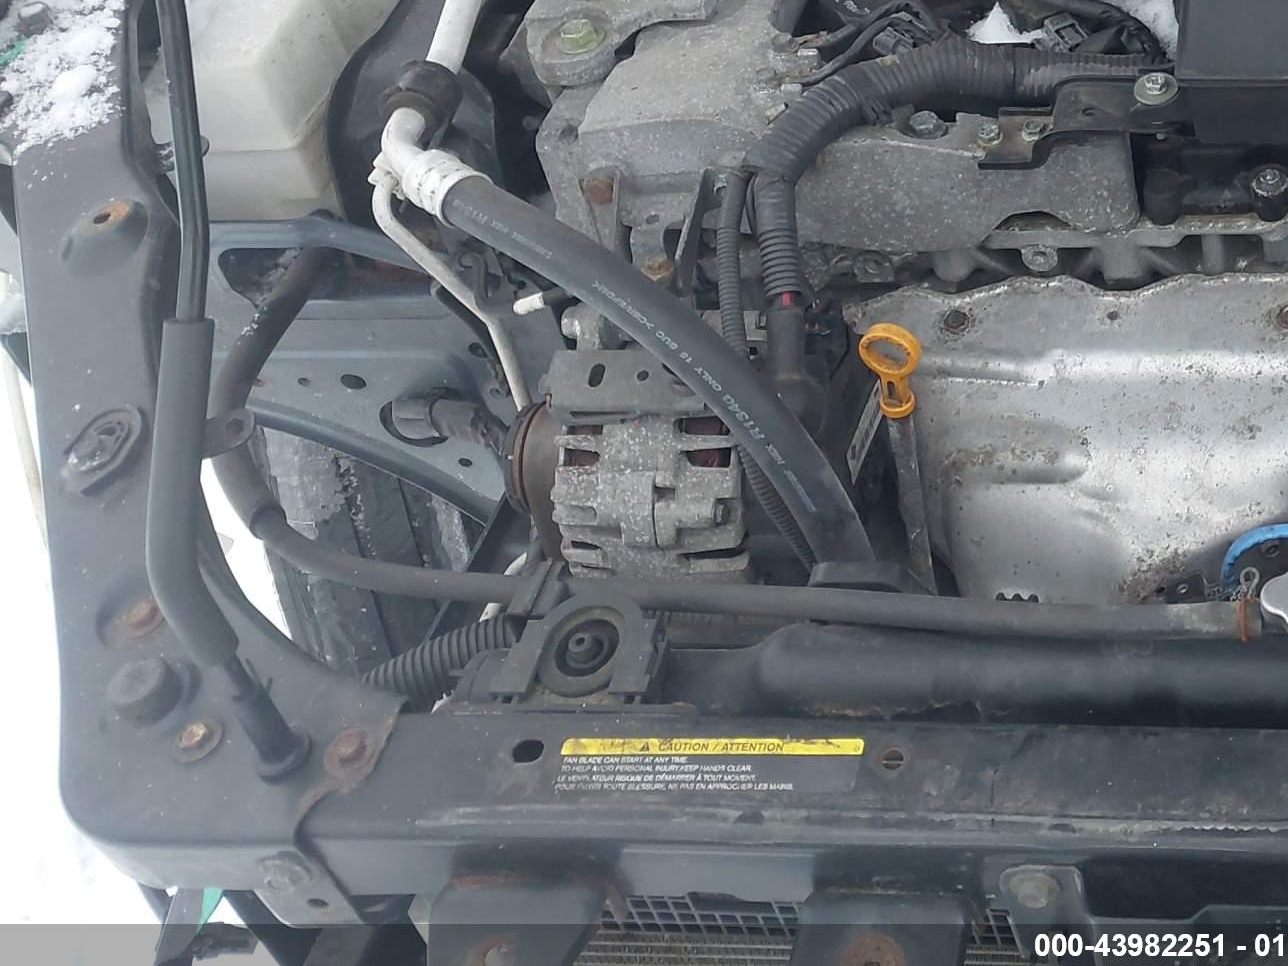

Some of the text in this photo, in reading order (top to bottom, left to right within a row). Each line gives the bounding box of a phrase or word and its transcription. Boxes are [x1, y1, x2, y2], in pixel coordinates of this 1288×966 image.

[694, 366, 723, 392] ONLY
[658, 742, 709, 752] CAUTION
[720, 742, 785, 752] ATTENTION
[578, 756, 602, 764] BLADE
[603, 756, 620, 764] CAN
[653, 756, 670, 764] ANY
